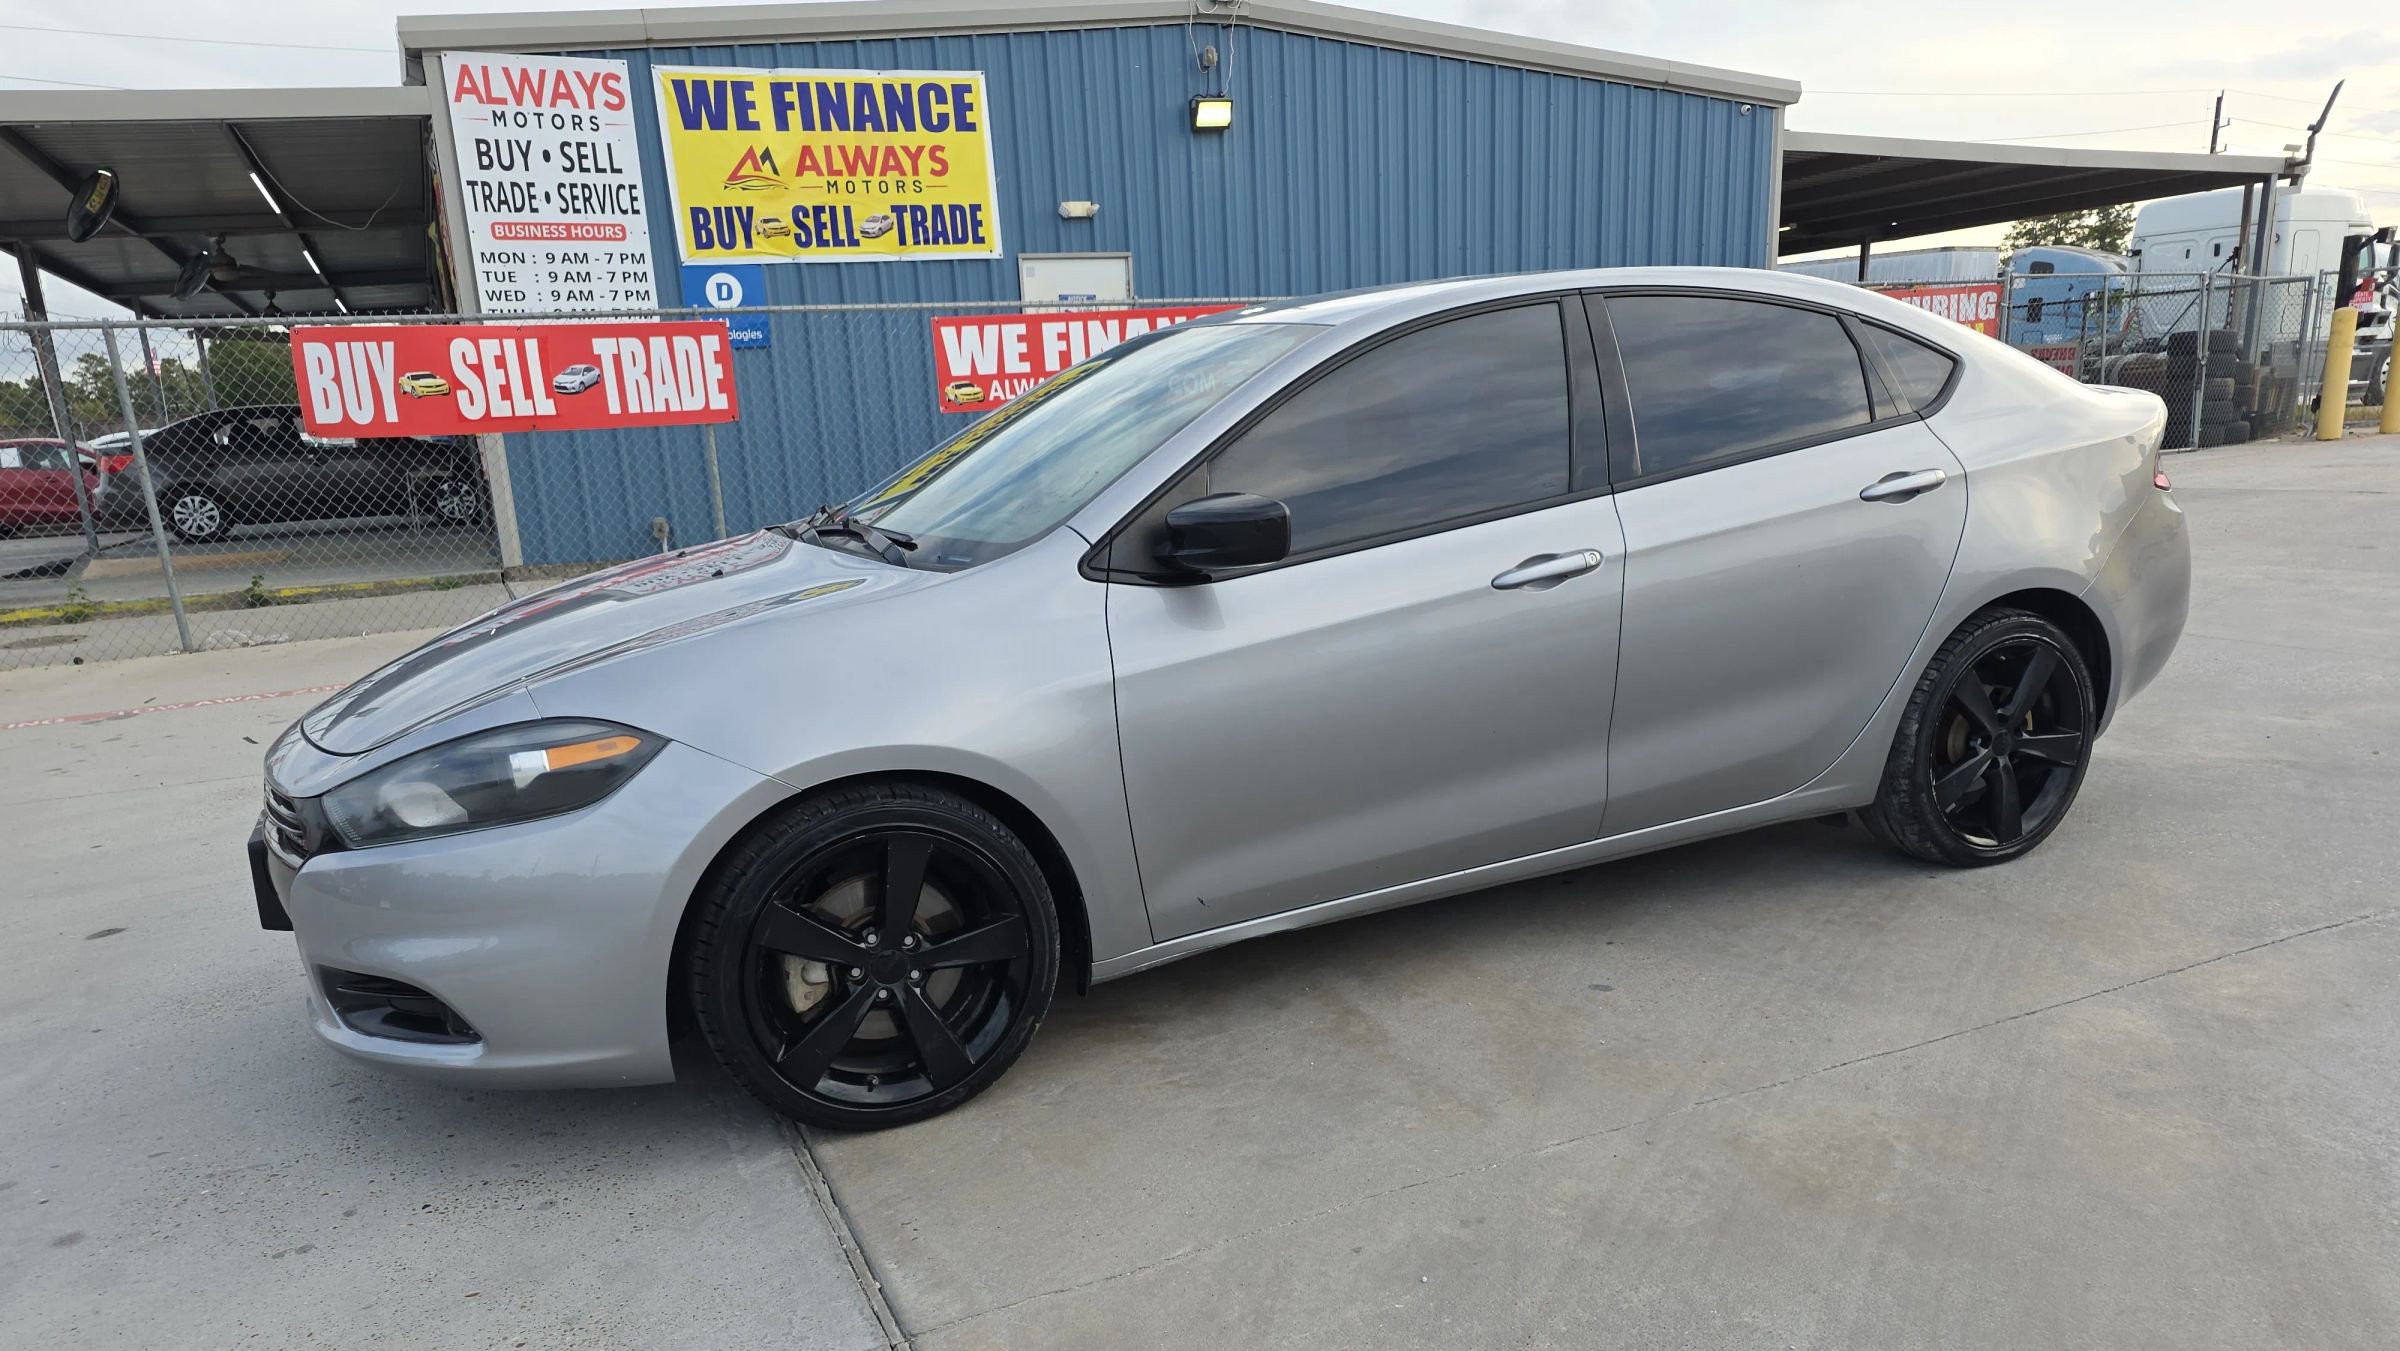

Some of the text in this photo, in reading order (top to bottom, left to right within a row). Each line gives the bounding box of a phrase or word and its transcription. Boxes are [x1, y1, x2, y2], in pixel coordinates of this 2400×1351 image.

[454, 63, 626, 111] ALWAYS
[671, 79, 977, 133] WE FINANCE
[491, 110, 600, 132] MOTORS
[475, 138, 623, 174] BUY SELL
[795, 144, 950, 178] ALWAYS
[466, 180, 641, 215] TRADE SERVICE
[827, 179, 923, 194] MOTORS
[494, 224, 623, 239] BUSINESS HOURS
[689, 203, 986, 250] BUY SELL TRADE
[480, 252, 526, 264] MON
[545, 252, 556, 264] 9
[561, 252, 589, 264] AM
[604, 253, 614, 264] 7
[619, 252, 646, 264] PM
[482, 271, 518, 283] TUE
[548, 271, 558, 283] 9
[563, 271, 592, 283] AM
[606, 271, 617, 283] 7
[622, 271, 648, 283] PM
[485, 290, 526, 302] WED
[550, 290, 561, 302] 9
[566, 290, 594, 302] AM
[609, 290, 619, 302] 7
[624, 290, 650, 302] PM
[1902, 291, 1998, 322] IRING
[728, 329, 763, 342] ologies
[940, 323, 1031, 377] WE
[302, 334, 729, 425] BUY SELL TRADE
[989, 377, 1045, 401] ALW
[194, 692, 280, 706] AWAY
